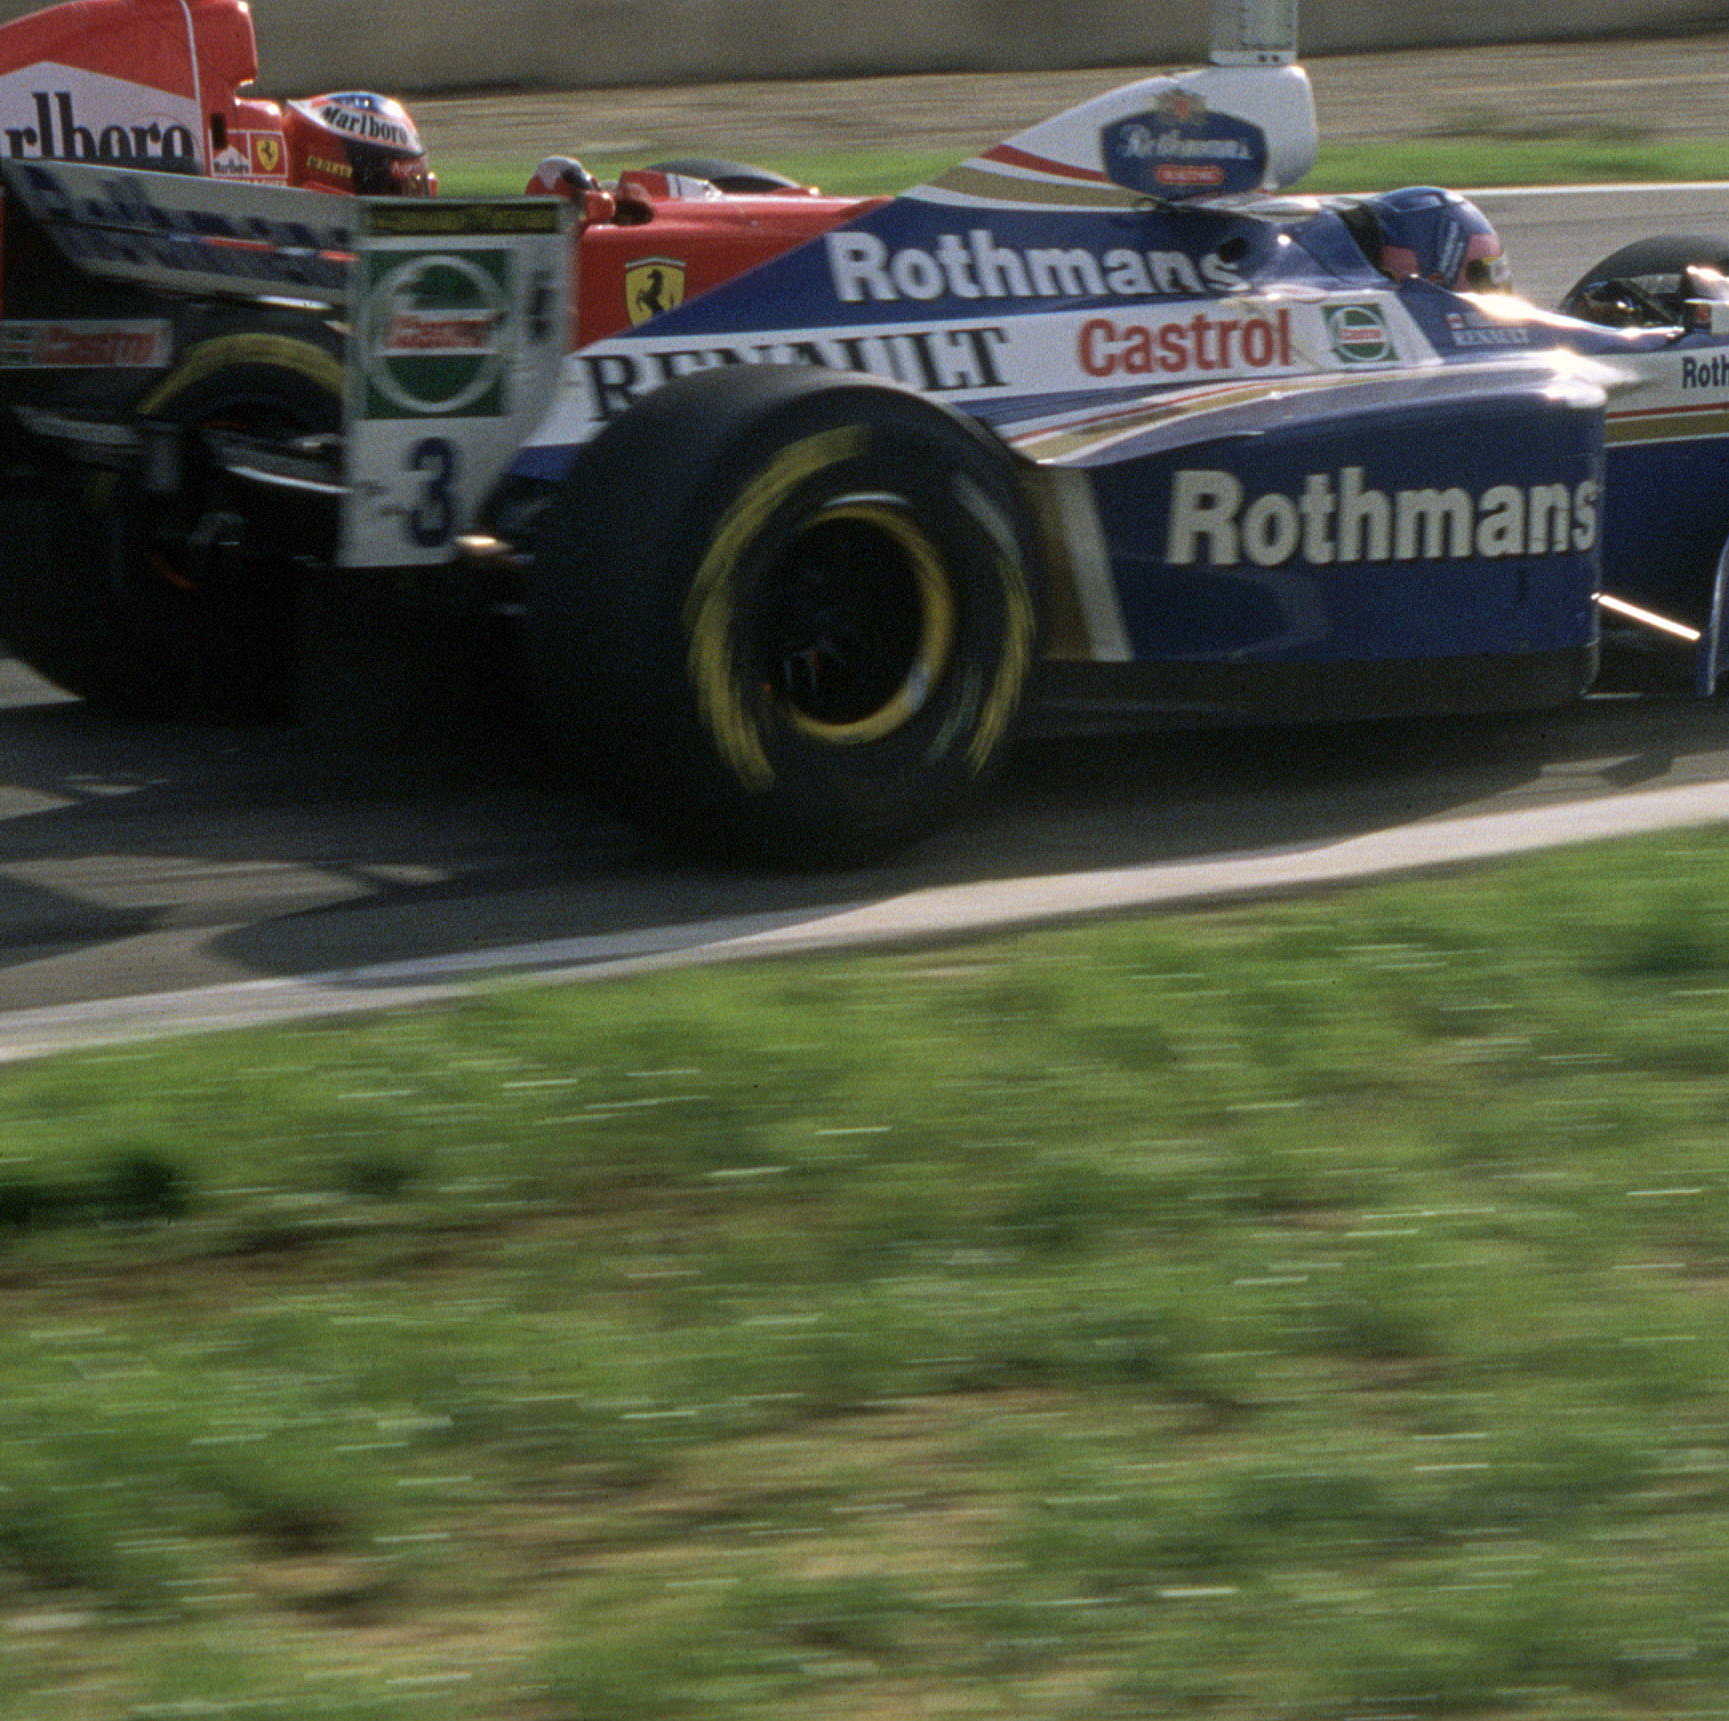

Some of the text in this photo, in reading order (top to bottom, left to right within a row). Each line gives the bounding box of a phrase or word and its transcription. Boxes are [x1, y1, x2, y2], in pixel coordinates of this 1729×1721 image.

[322, 106, 409, 145] Marlboro
[825, 229, 1251, 302] Rothmans
[574, 327, 1008, 422] RULT
[1076, 308, 1291, 378] Castrol
[406, 437, 456, 548] 3
[1165, 467, 1597, 568] Rothmans
